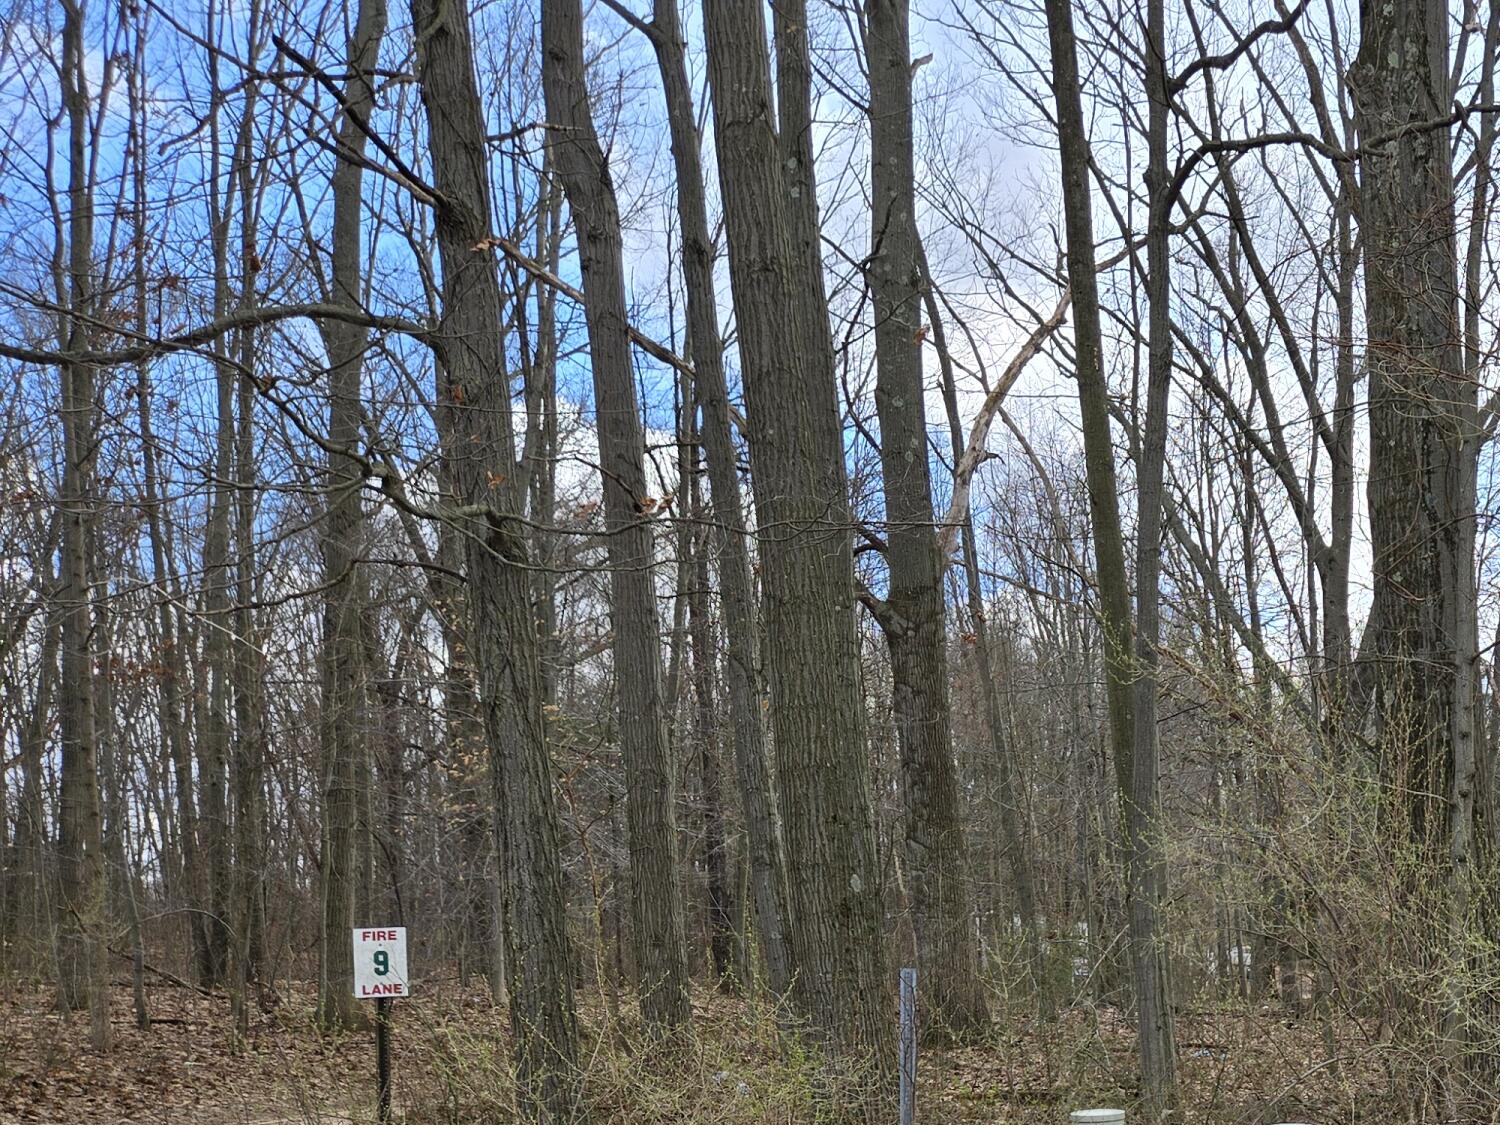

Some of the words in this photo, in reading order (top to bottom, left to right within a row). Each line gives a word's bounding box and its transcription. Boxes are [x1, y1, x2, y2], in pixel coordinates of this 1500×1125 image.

[362, 930, 397, 941] FIRE
[373, 950, 389, 976] 9
[362, 983, 402, 995] LANE
